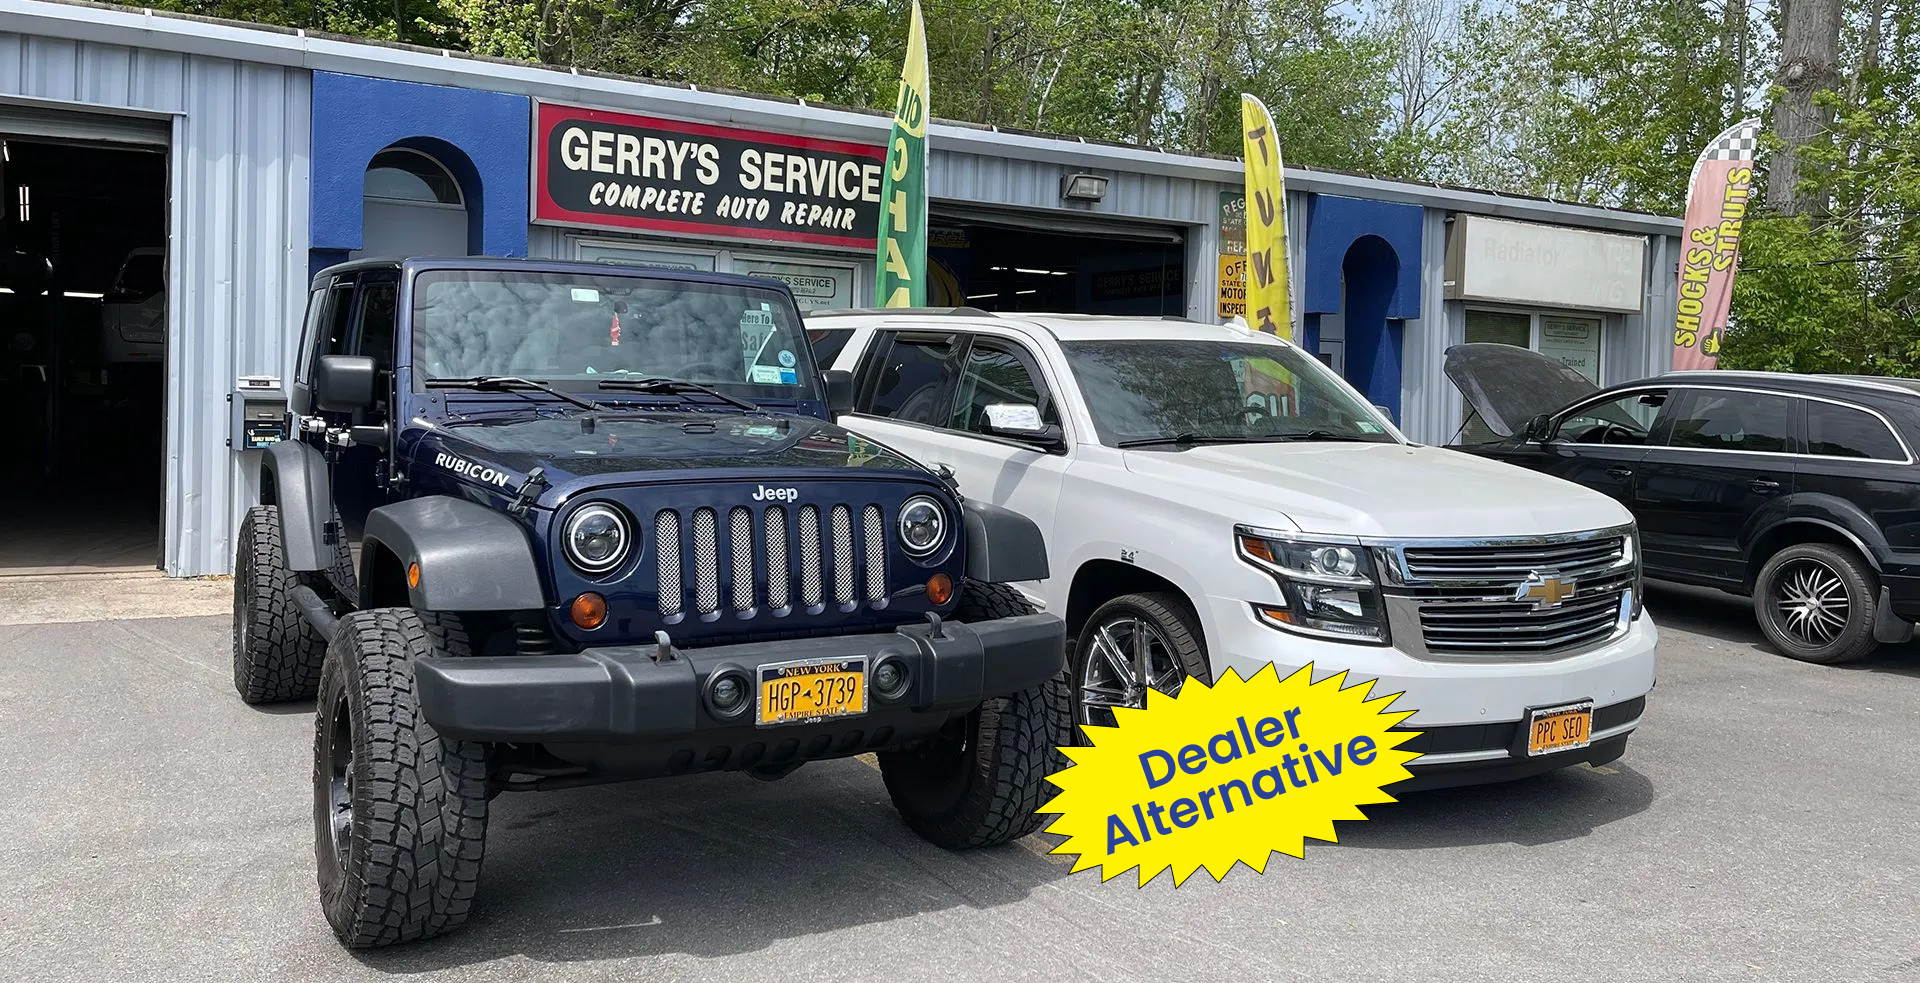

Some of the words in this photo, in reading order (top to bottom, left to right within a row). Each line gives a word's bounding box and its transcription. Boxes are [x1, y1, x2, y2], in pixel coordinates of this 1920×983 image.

[560, 127, 720, 186] GERRY'S
[739, 149, 881, 202] SERVICE
[589, 181, 705, 216] COMPLETE
[716, 194, 770, 222] AUTO
[780, 201, 856, 231] REPAIR
[1713, 167, 1751, 272] STRUTS
[793, 277, 831, 288] SERVICE
[1674, 247, 1713, 348] SHOCKS
[435, 453, 510, 488] RUBICON
[752, 485, 799, 503] Jeep
[785, 666, 812, 677] NEW
[814, 663, 841, 674] YORK
[768, 681, 801, 713] HGP
[814, 676, 856, 707] 3739
[784, 710, 813, 719] EMPIRE
[815, 706, 839, 716] STATE
[1536, 720, 1557, 745] PPC
[1562, 716, 1582, 740] SEO
